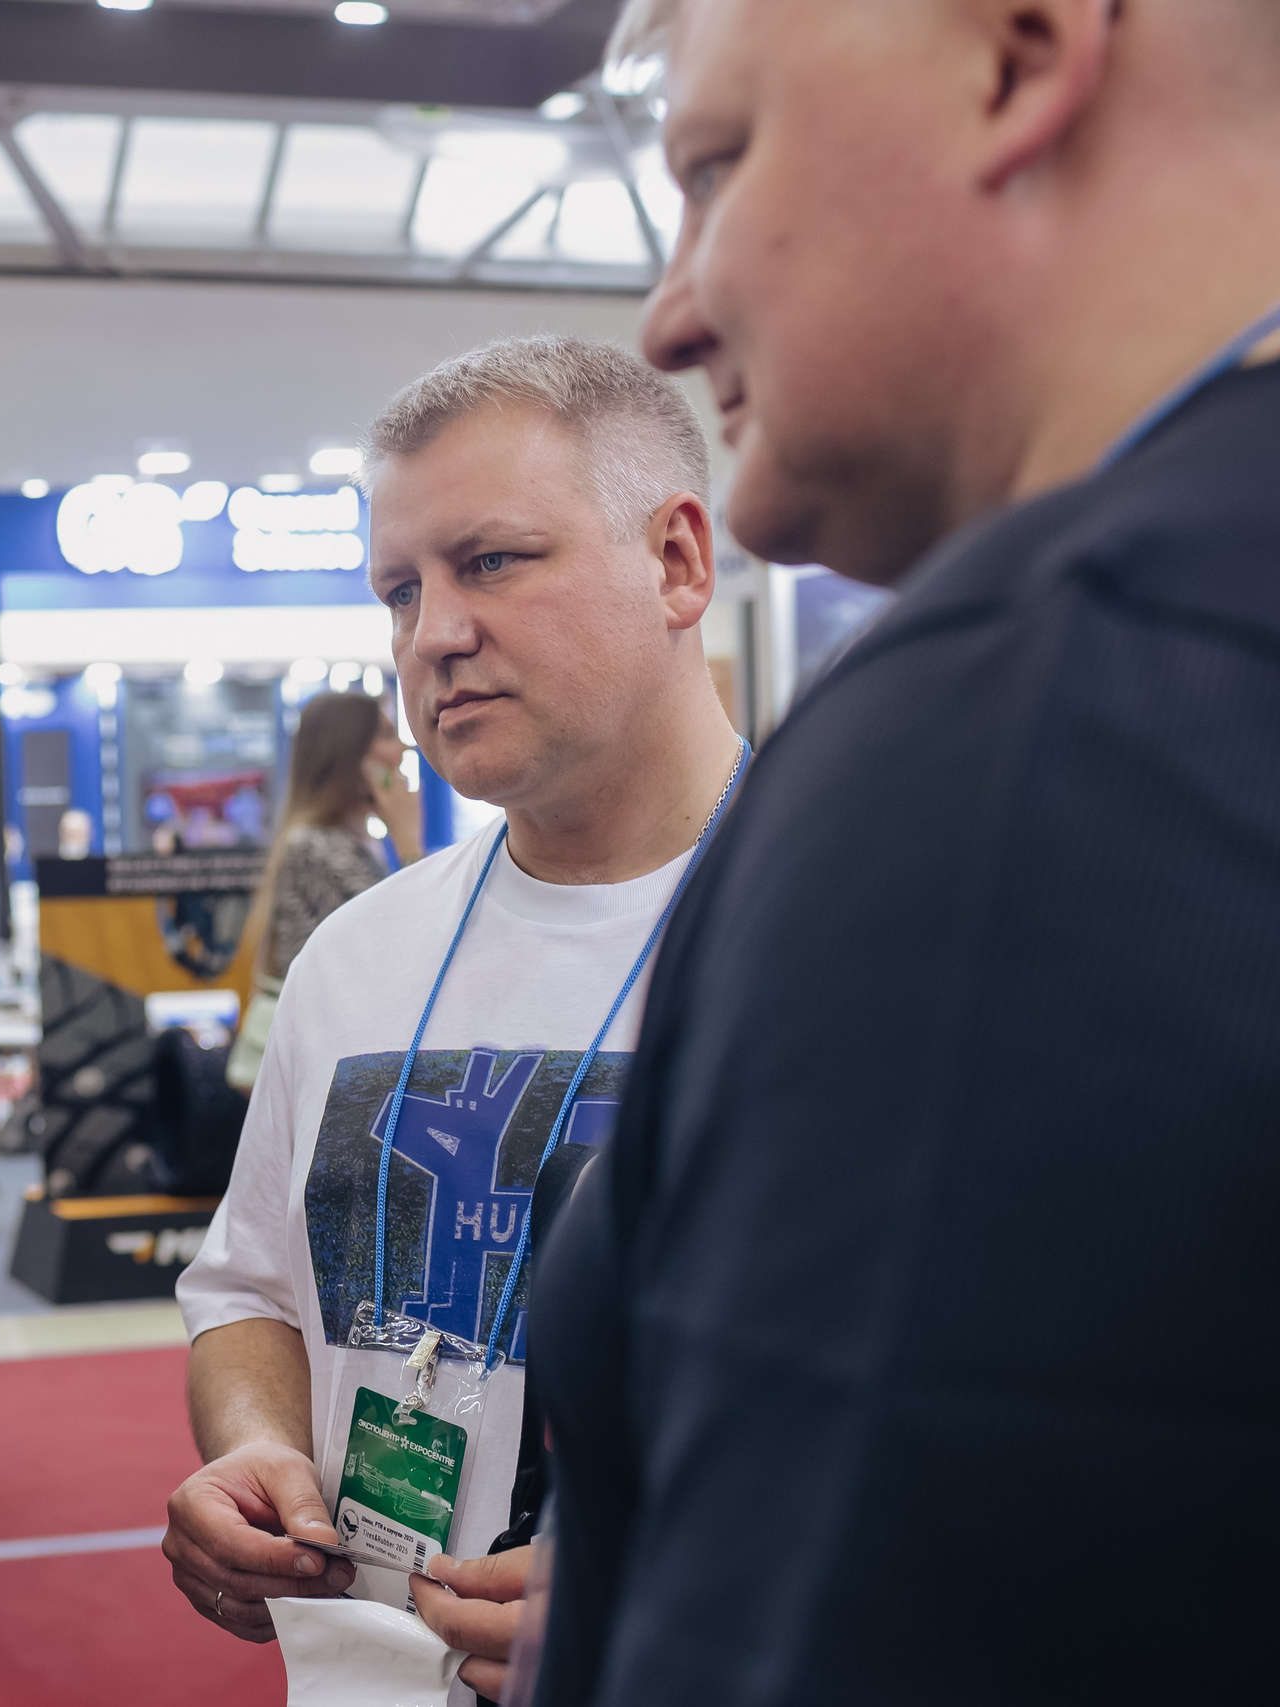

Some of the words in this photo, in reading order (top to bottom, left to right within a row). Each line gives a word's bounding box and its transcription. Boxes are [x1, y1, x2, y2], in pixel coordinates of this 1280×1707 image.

[454, 1201, 526, 1243] HU
[358, 1418, 400, 1443] ЭКСПОЦЕНТР
[409, 1442, 456, 1468] EXPOCENTRE
[362, 1529, 395, 1549] Tires&Rubber
[395, 1545, 409, 1555] 2025
